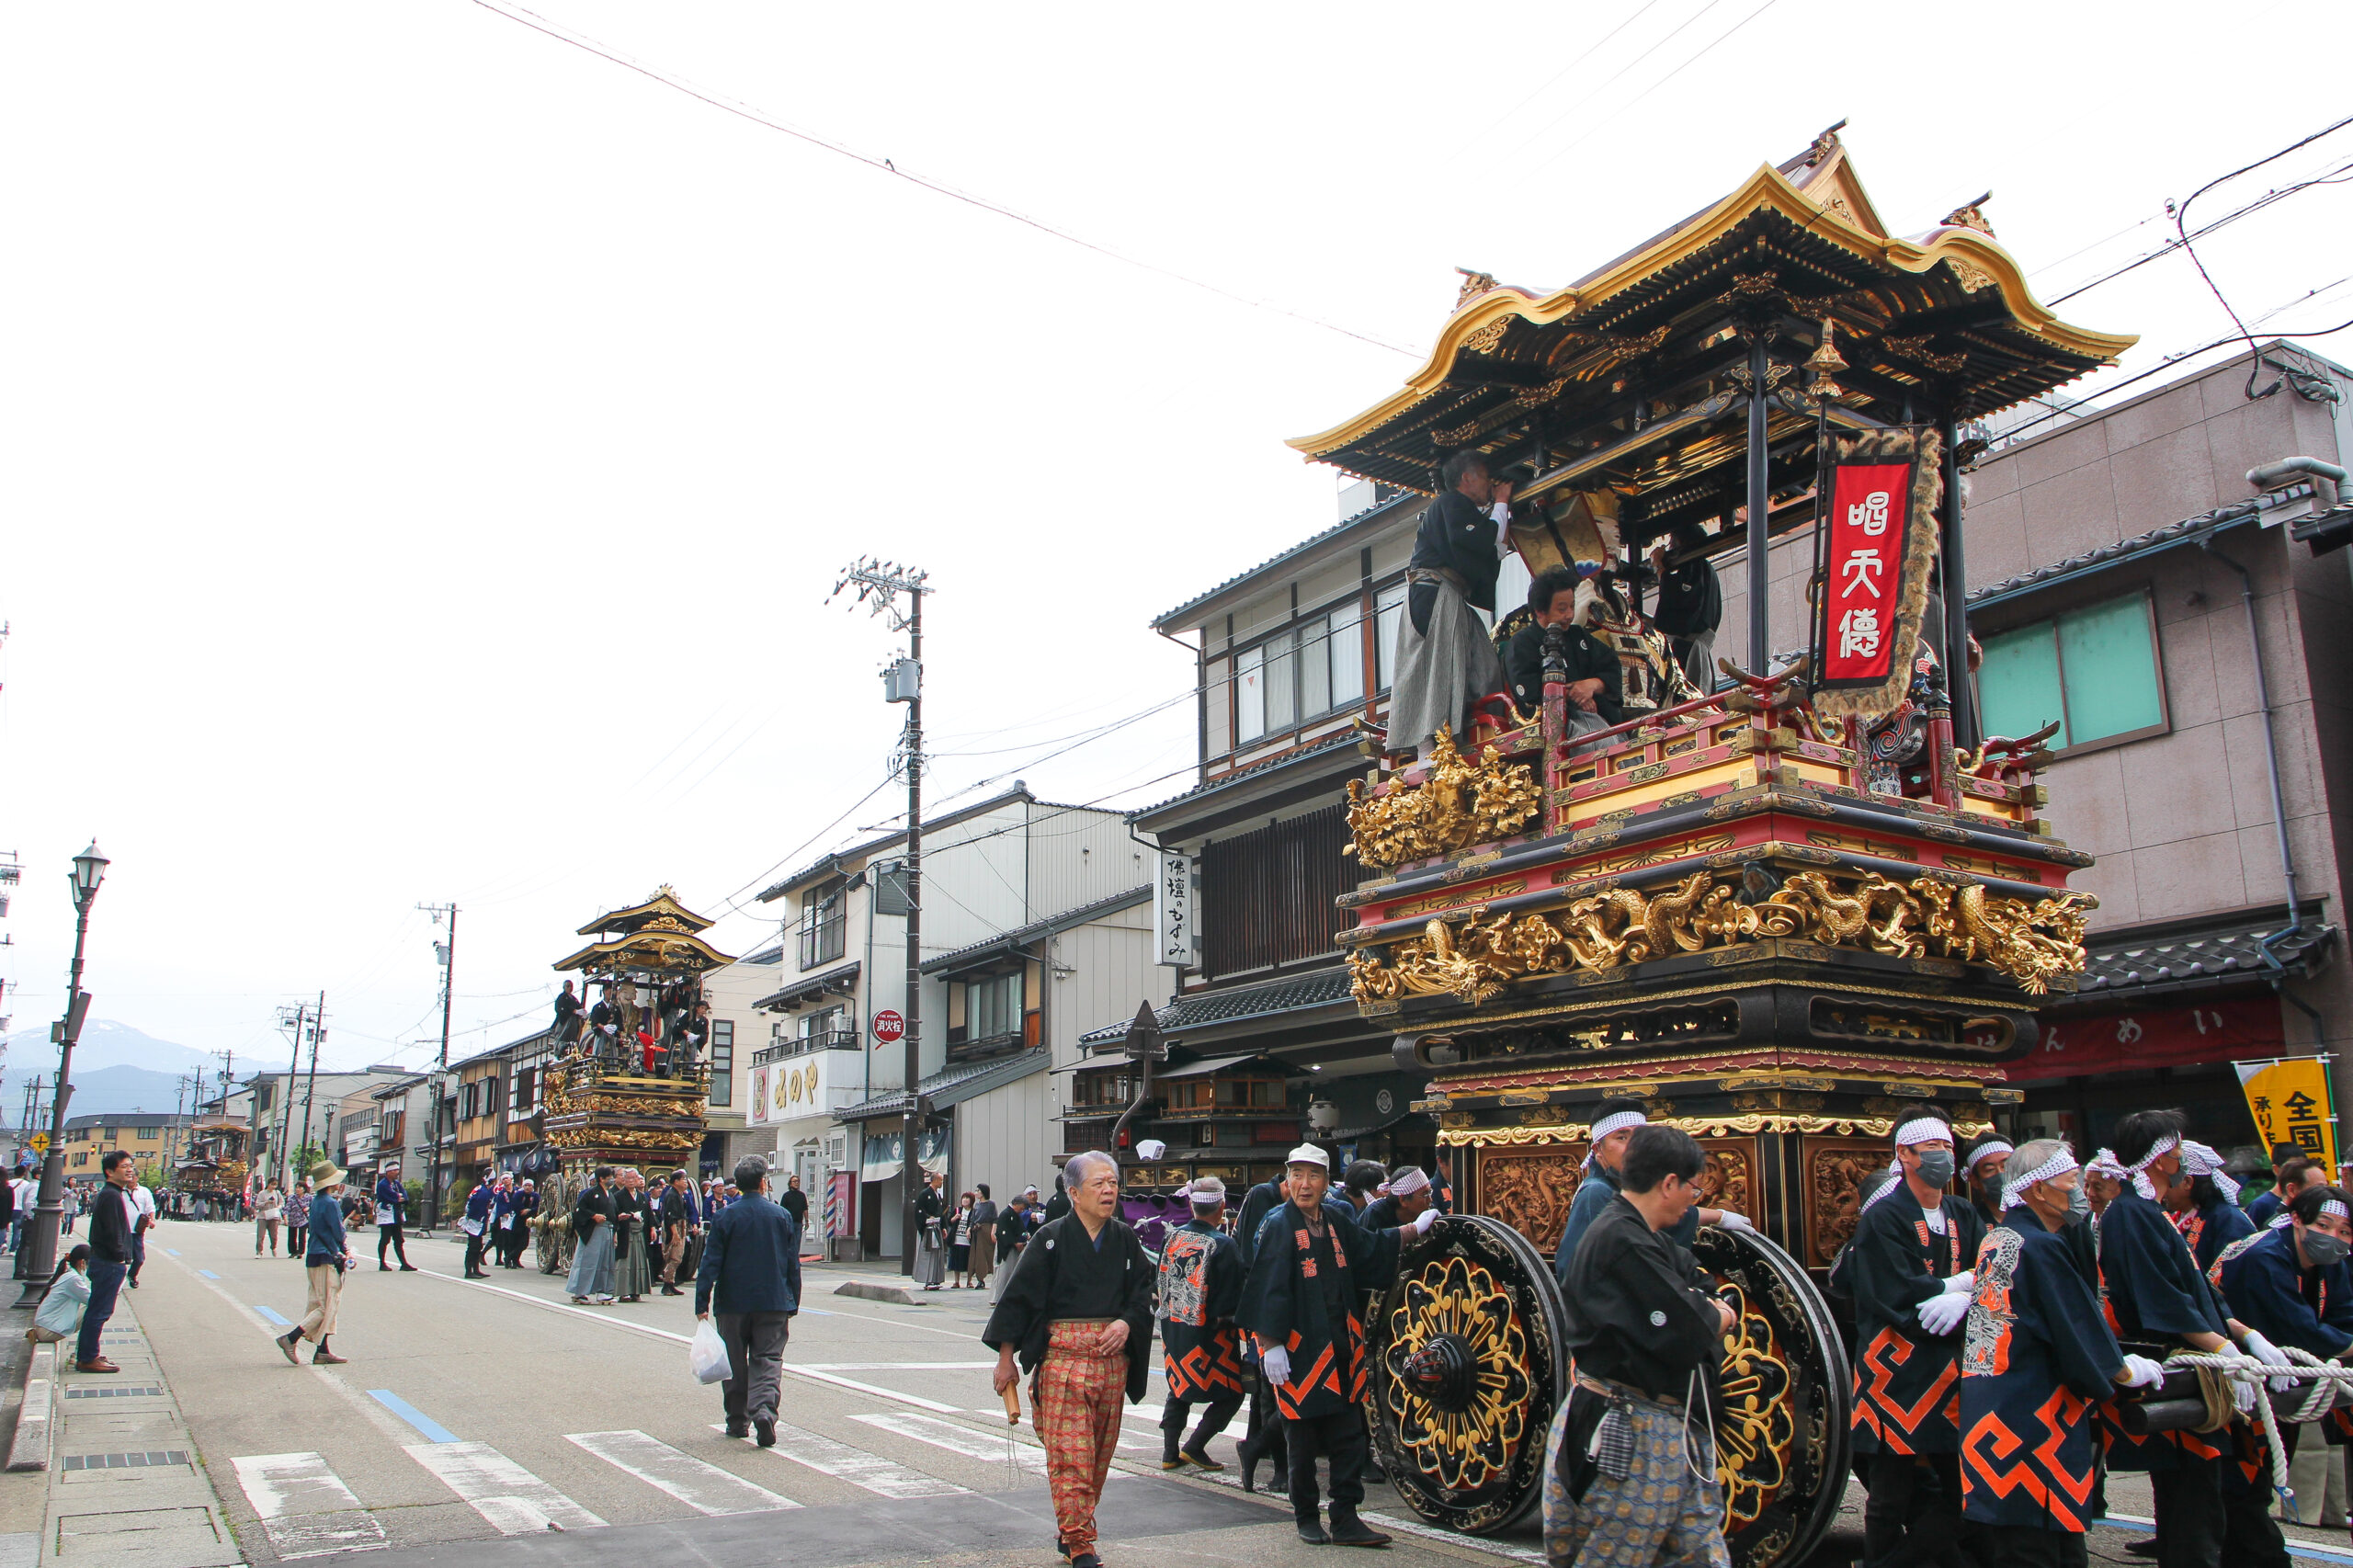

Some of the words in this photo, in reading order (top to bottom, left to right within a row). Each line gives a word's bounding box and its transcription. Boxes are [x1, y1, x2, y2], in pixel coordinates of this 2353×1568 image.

[877, 1019, 902, 1033] 消火栓
[775, 1059, 818, 1109] みのや
